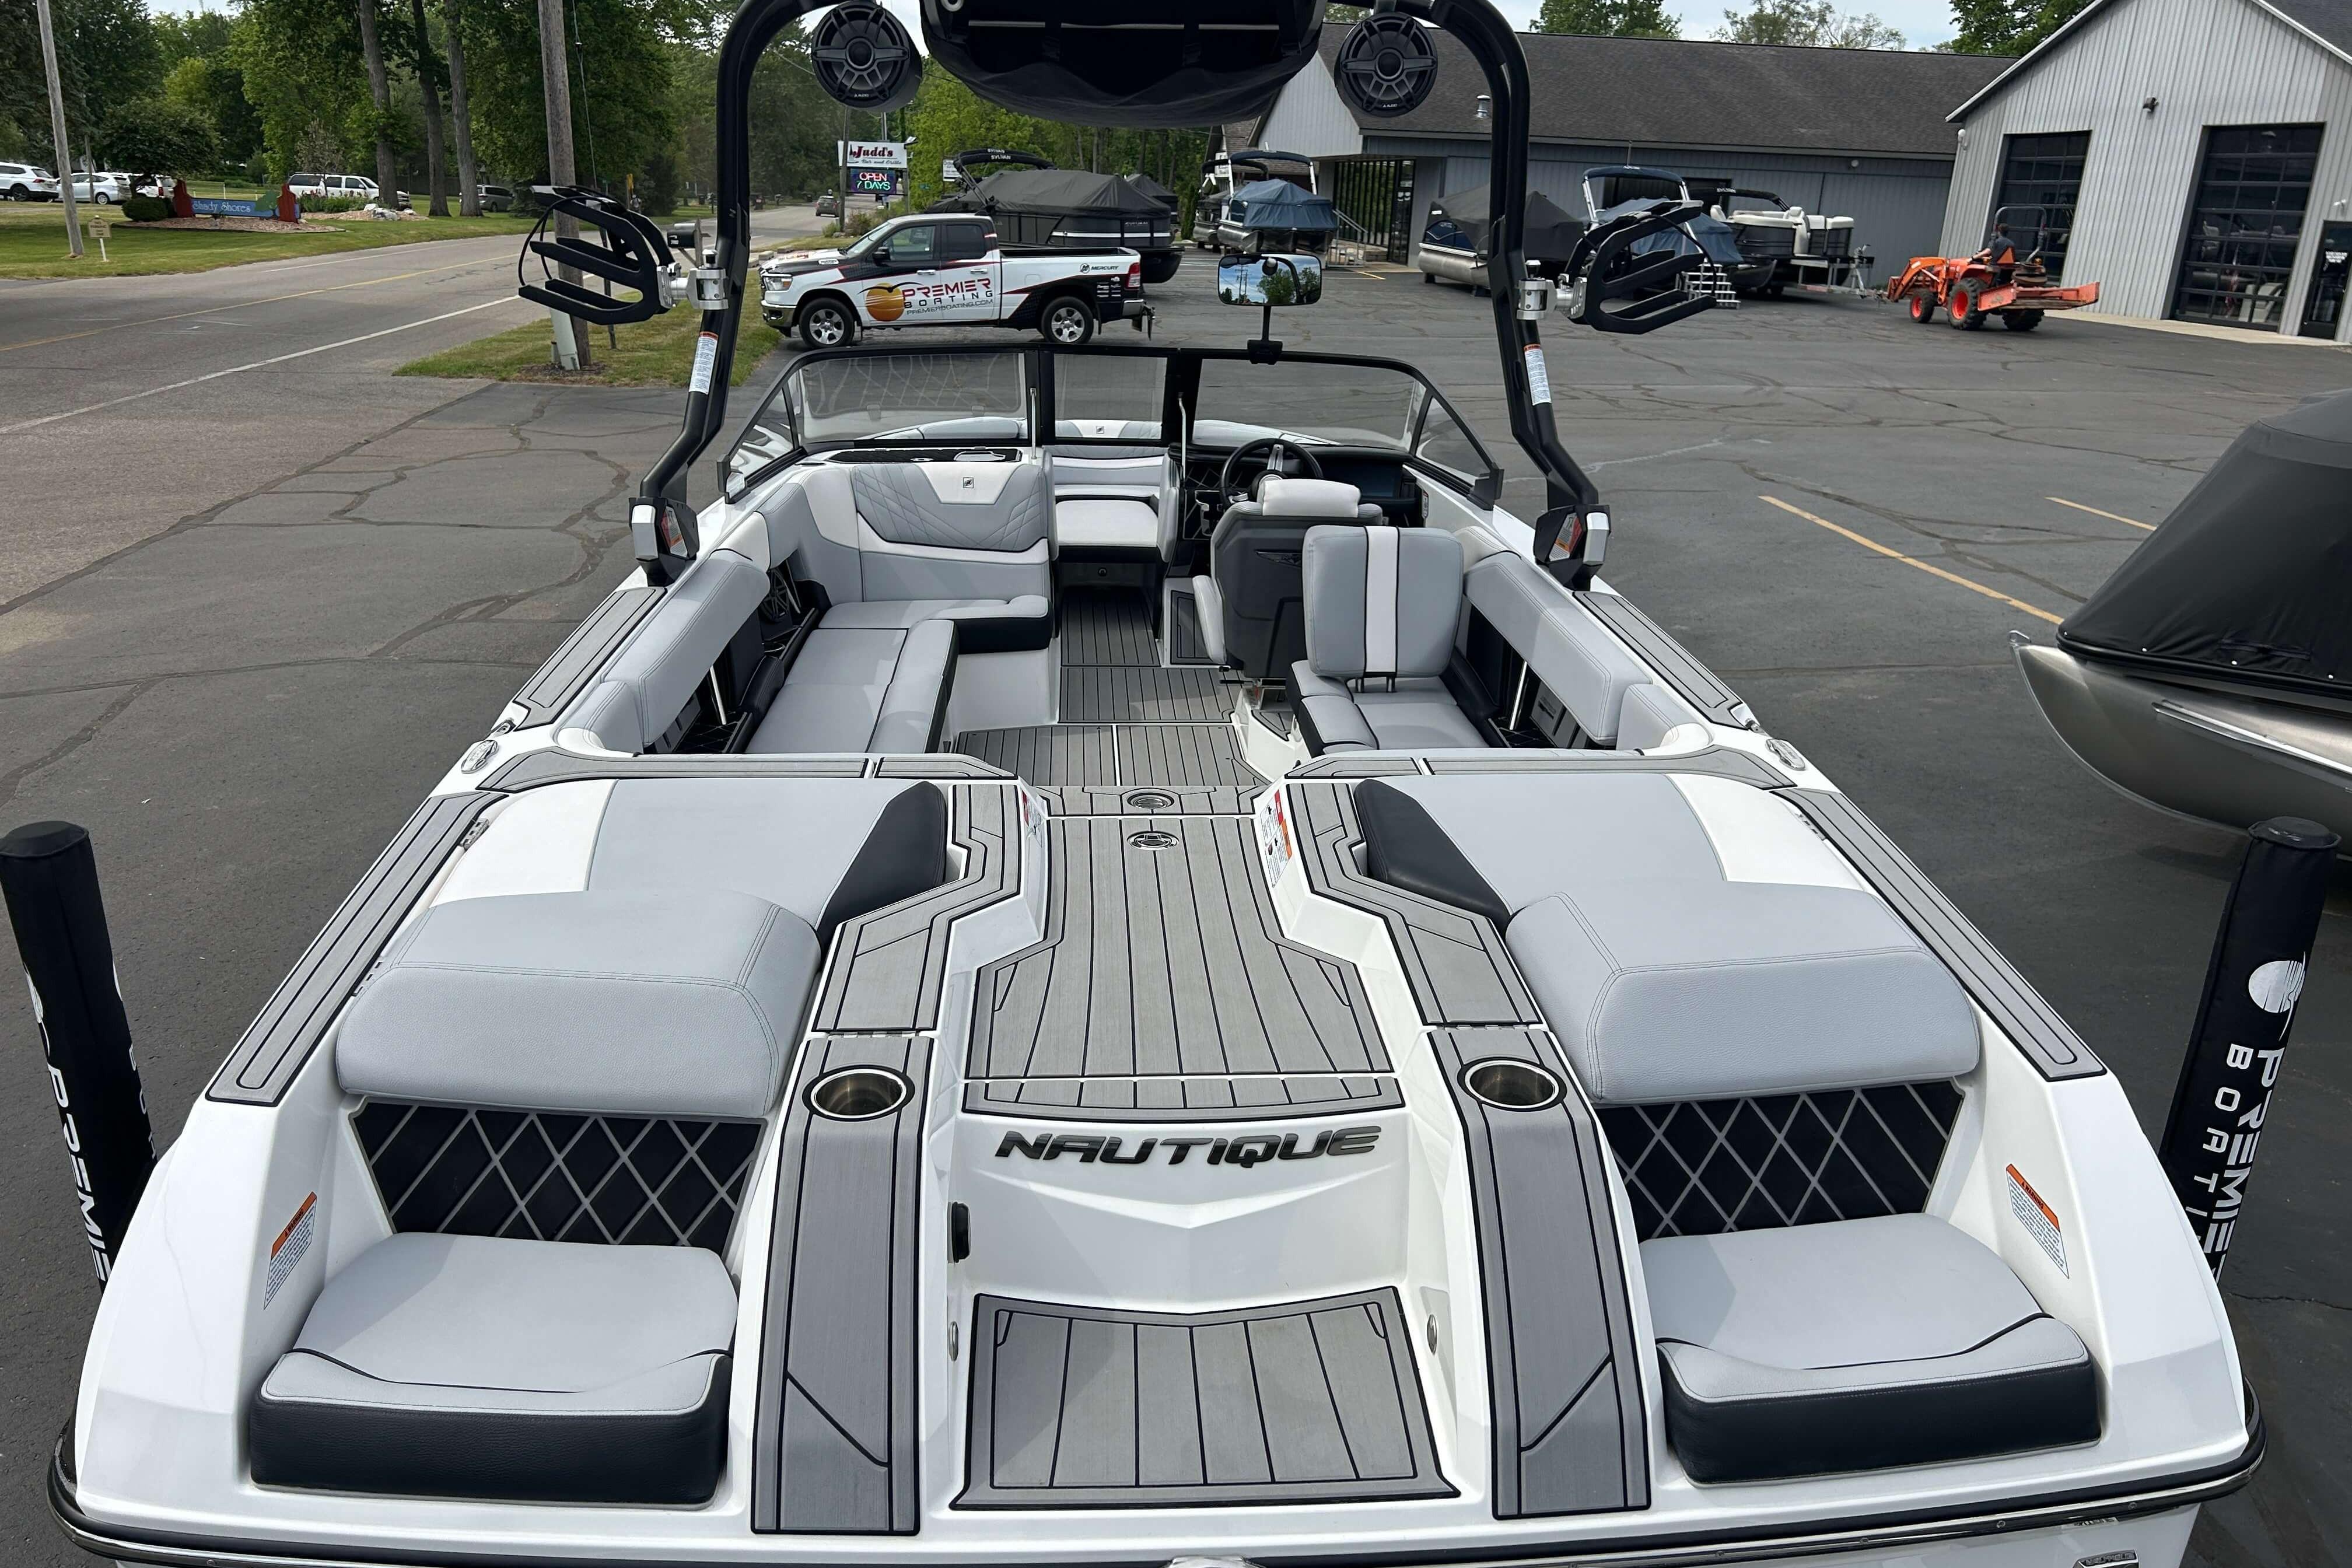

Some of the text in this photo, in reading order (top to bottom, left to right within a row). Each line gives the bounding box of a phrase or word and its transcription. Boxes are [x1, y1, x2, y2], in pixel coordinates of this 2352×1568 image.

[855, 145, 893, 158] Judd's
[856, 180, 891, 190] 7 DAYS
[859, 172, 887, 181] OPEN
[192, 200, 251, 214] Shady Shores
[902, 278, 991, 298] PREMIER
[904, 290, 993, 309] BOATING
[907, 299, 993, 315] PREMIERBOATING.COM
[994, 1125, 1382, 1168] NAUTIQUE
[2185, 1043, 2254, 1241] BOATI
[2025, 1185, 2044, 1210] WARNING
